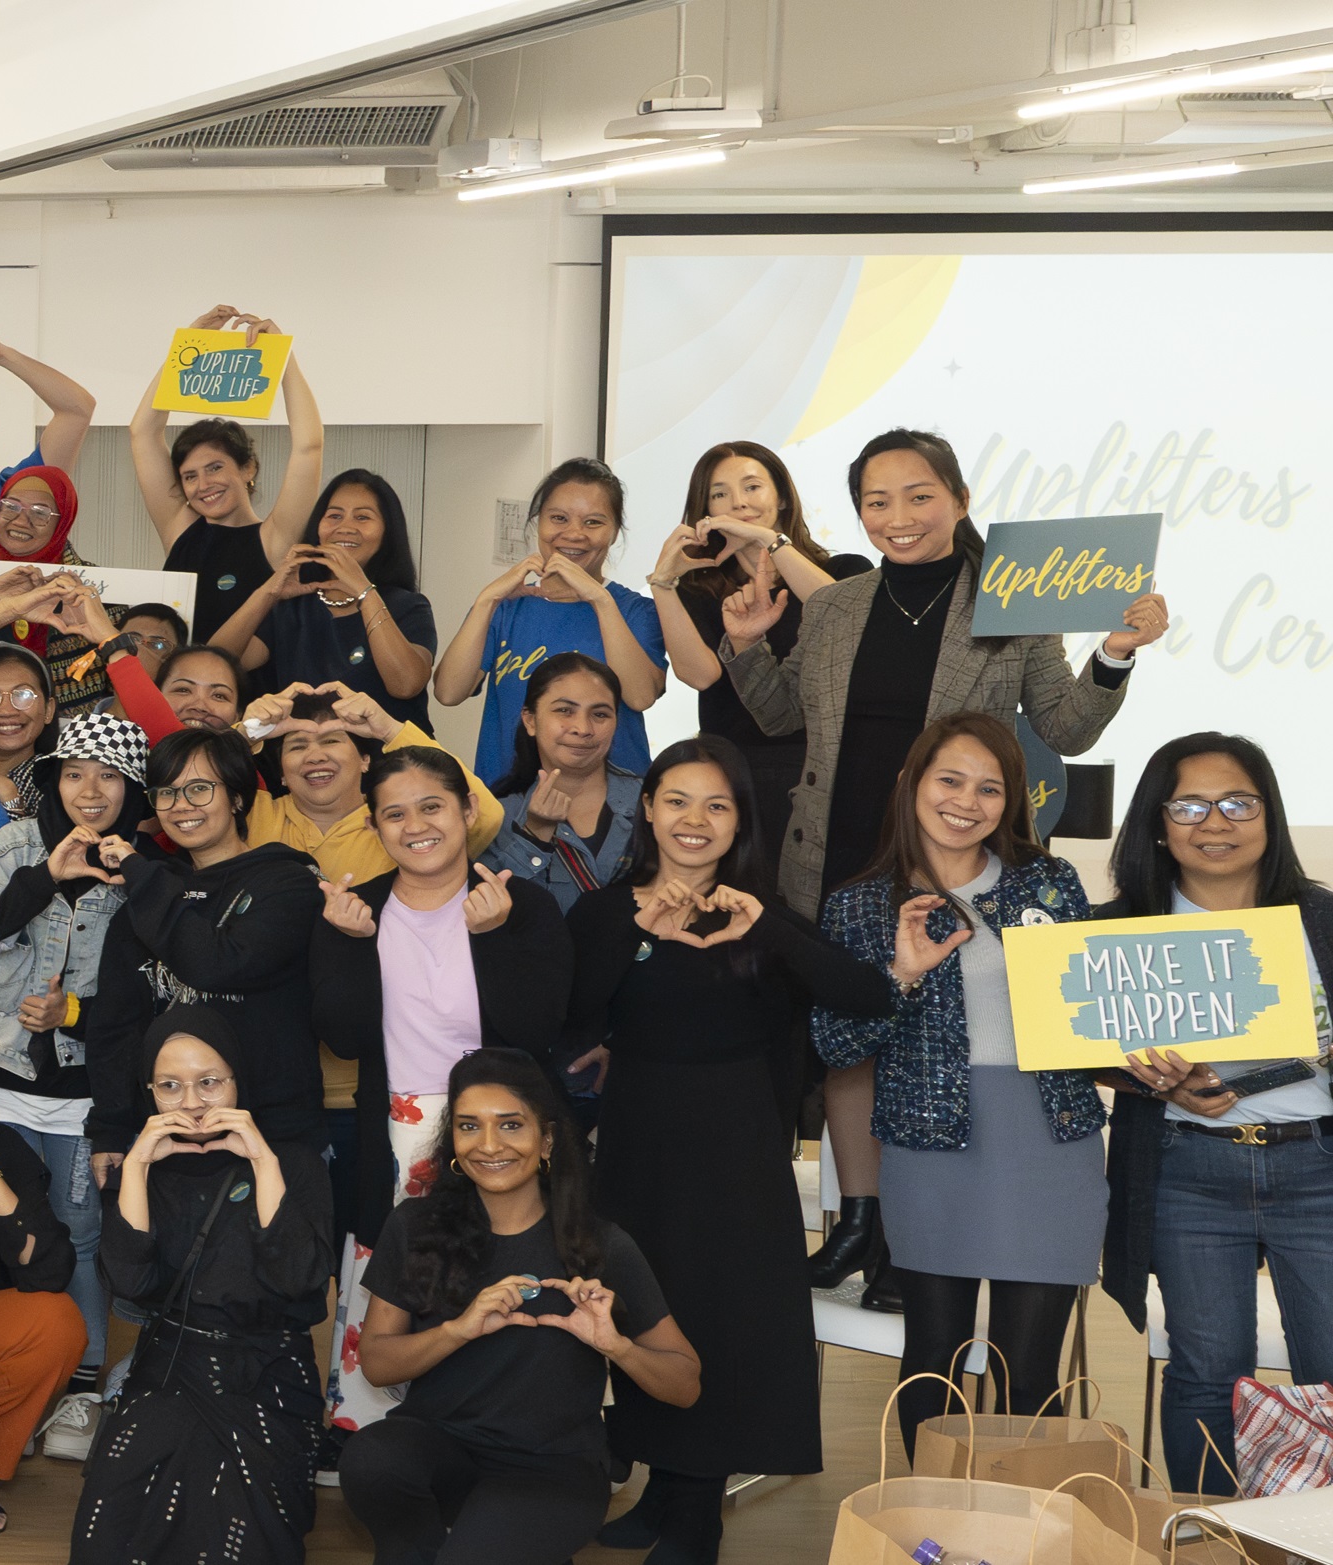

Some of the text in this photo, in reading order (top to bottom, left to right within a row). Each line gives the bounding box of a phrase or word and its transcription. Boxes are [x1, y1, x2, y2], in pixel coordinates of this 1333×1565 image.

[181, 374, 259, 400] YOUR LIFE
[199, 353, 253, 376] UPLIFT
[983, 546, 1153, 609] Uplifters
[1082, 938, 1237, 993] MAKE IT
[1098, 991, 1237, 1041] HAPPEN
